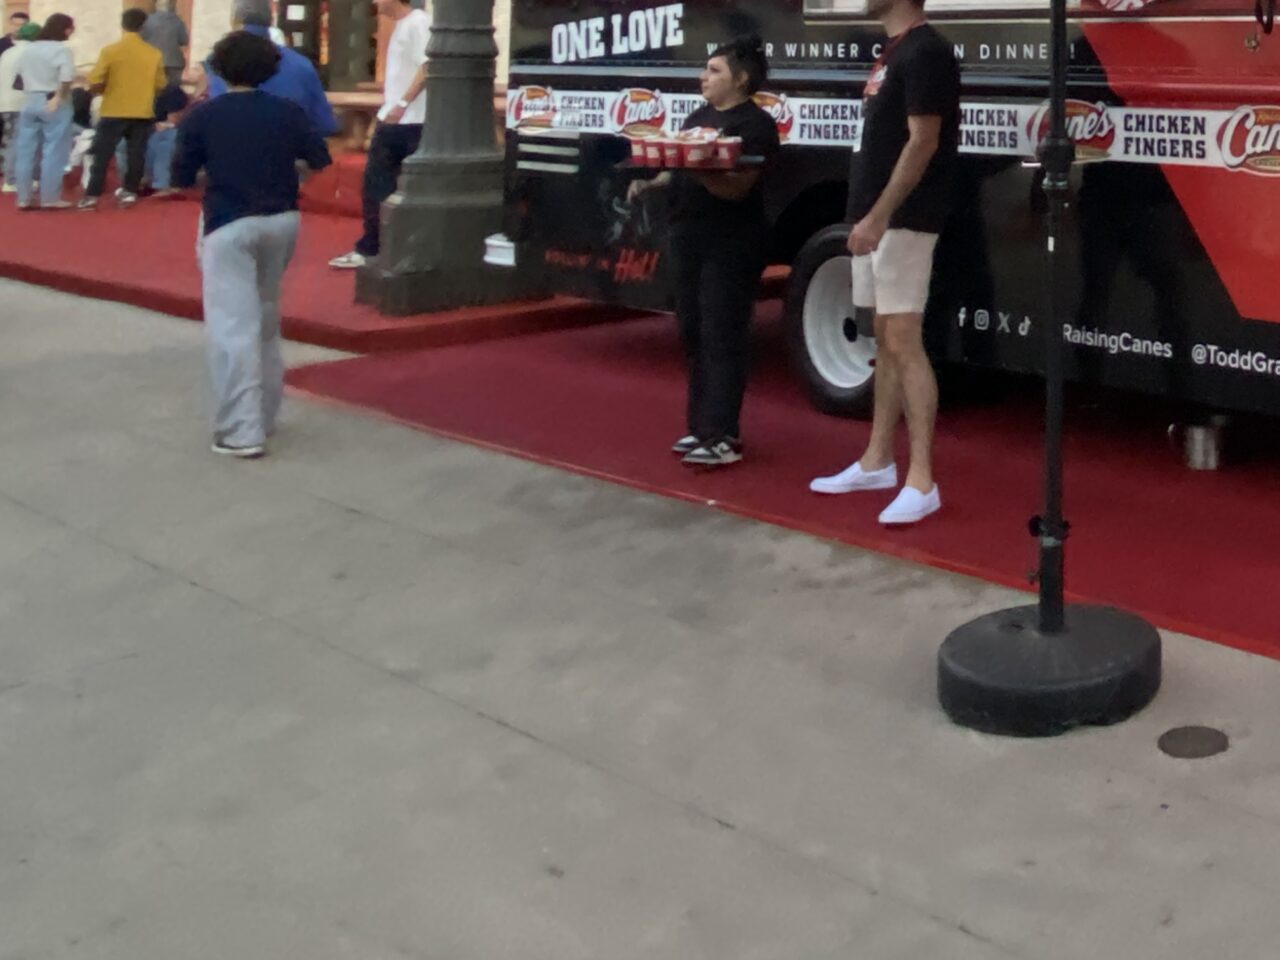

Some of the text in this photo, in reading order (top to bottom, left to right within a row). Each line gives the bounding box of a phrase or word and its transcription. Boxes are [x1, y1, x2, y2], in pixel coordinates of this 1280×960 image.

[552, 3, 684, 64] ONE LOVE
[785, 43, 859, 59] WINNER
[979, 43, 1076, 60] DINNE!
[800, 104, 860, 121] CHICKEN
[959, 109, 1018, 128] HICKEN
[800, 123, 858, 140] FINGERS
[1123, 113, 1207, 136] CHICKEN
[958, 129, 1018, 149] INGERS
[1123, 137, 1207, 159] FINGERS
